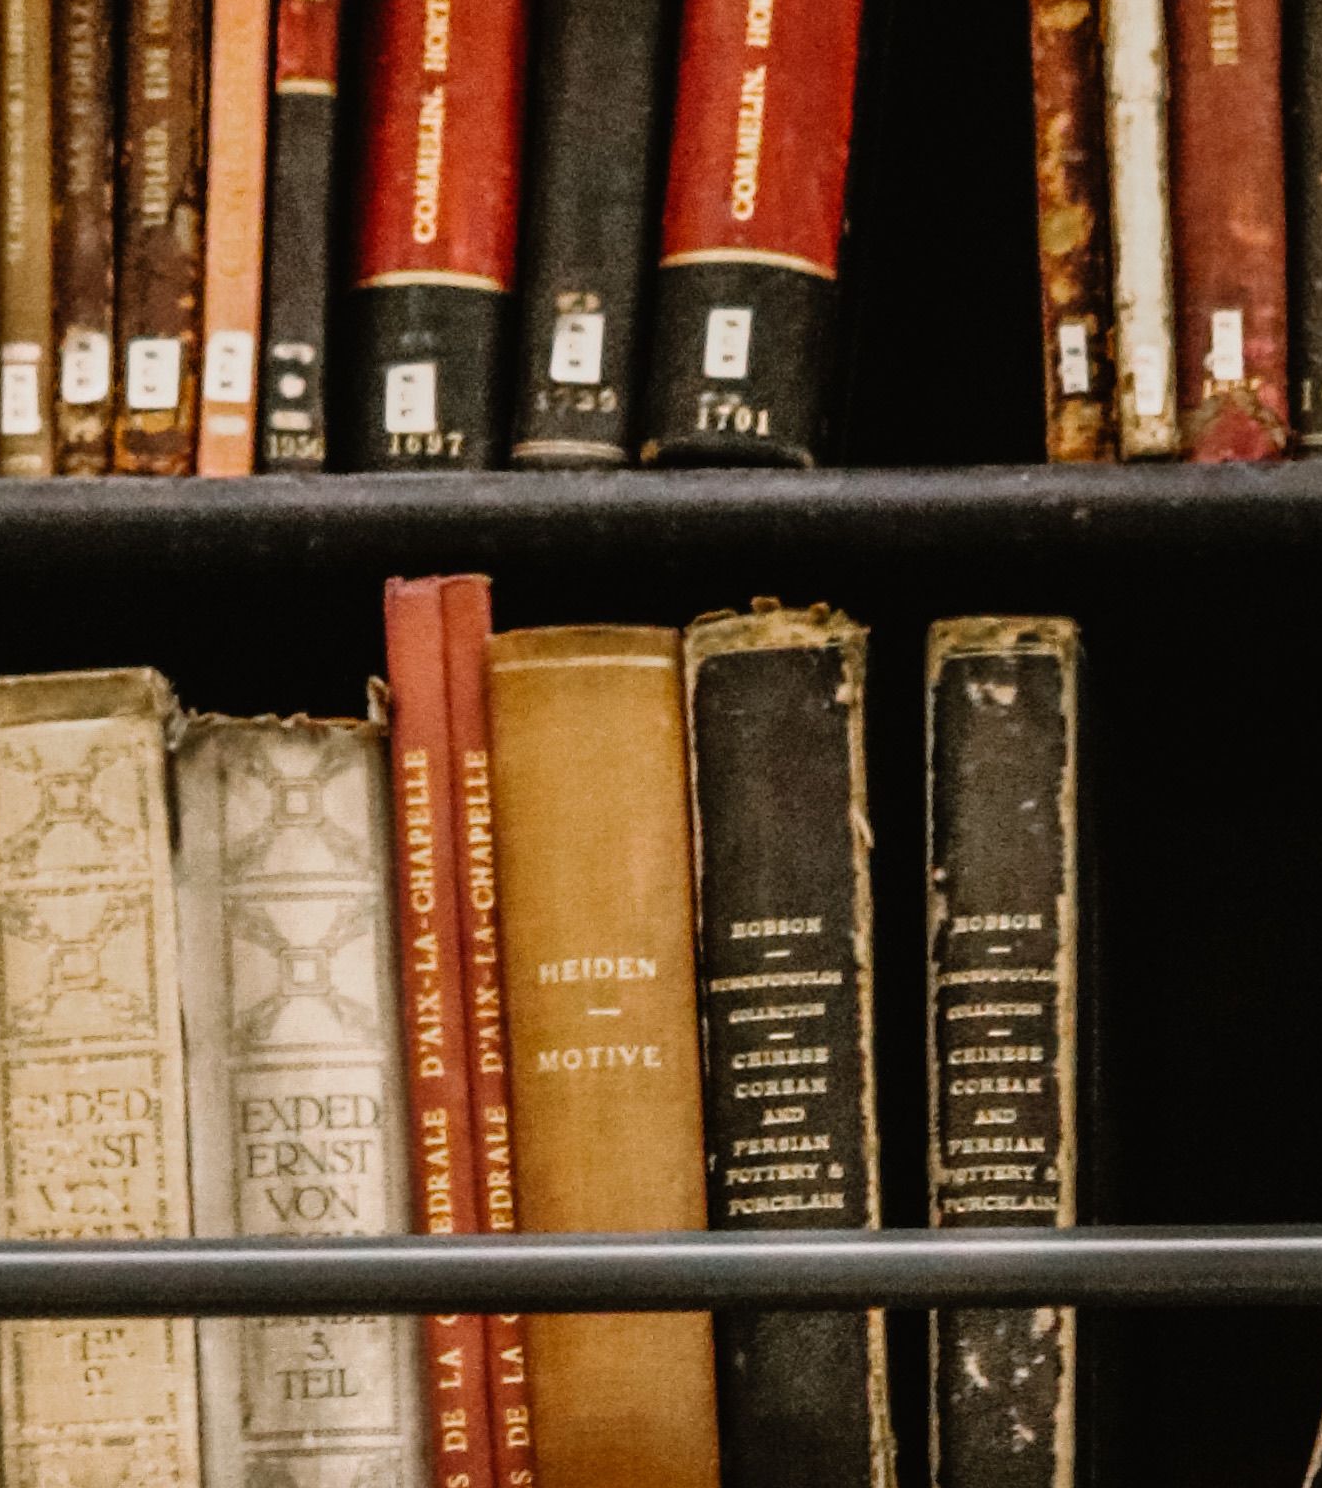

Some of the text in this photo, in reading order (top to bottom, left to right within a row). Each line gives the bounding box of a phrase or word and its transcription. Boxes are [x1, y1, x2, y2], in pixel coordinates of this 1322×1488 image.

[731, 916, 822, 939] HOBSON
[538, 956, 658, 985] HEIDEN
[537, 1046, 663, 1072] MOTIVE
[732, 1045, 829, 1068] CHINESE
[761, 1106, 805, 1126] AND
[245, 1141, 376, 1178] ERNST
[734, 1134, 830, 1157] PERSIAN
[265, 1186, 359, 1223] VON
[441, 1341, 465, 1391] LA
[506, 1342, 527, 1388] LA
[277, 1366, 358, 1400] TEIL
[444, 1404, 468, 1453] DE
[508, 1402, 530, 1448] DE
